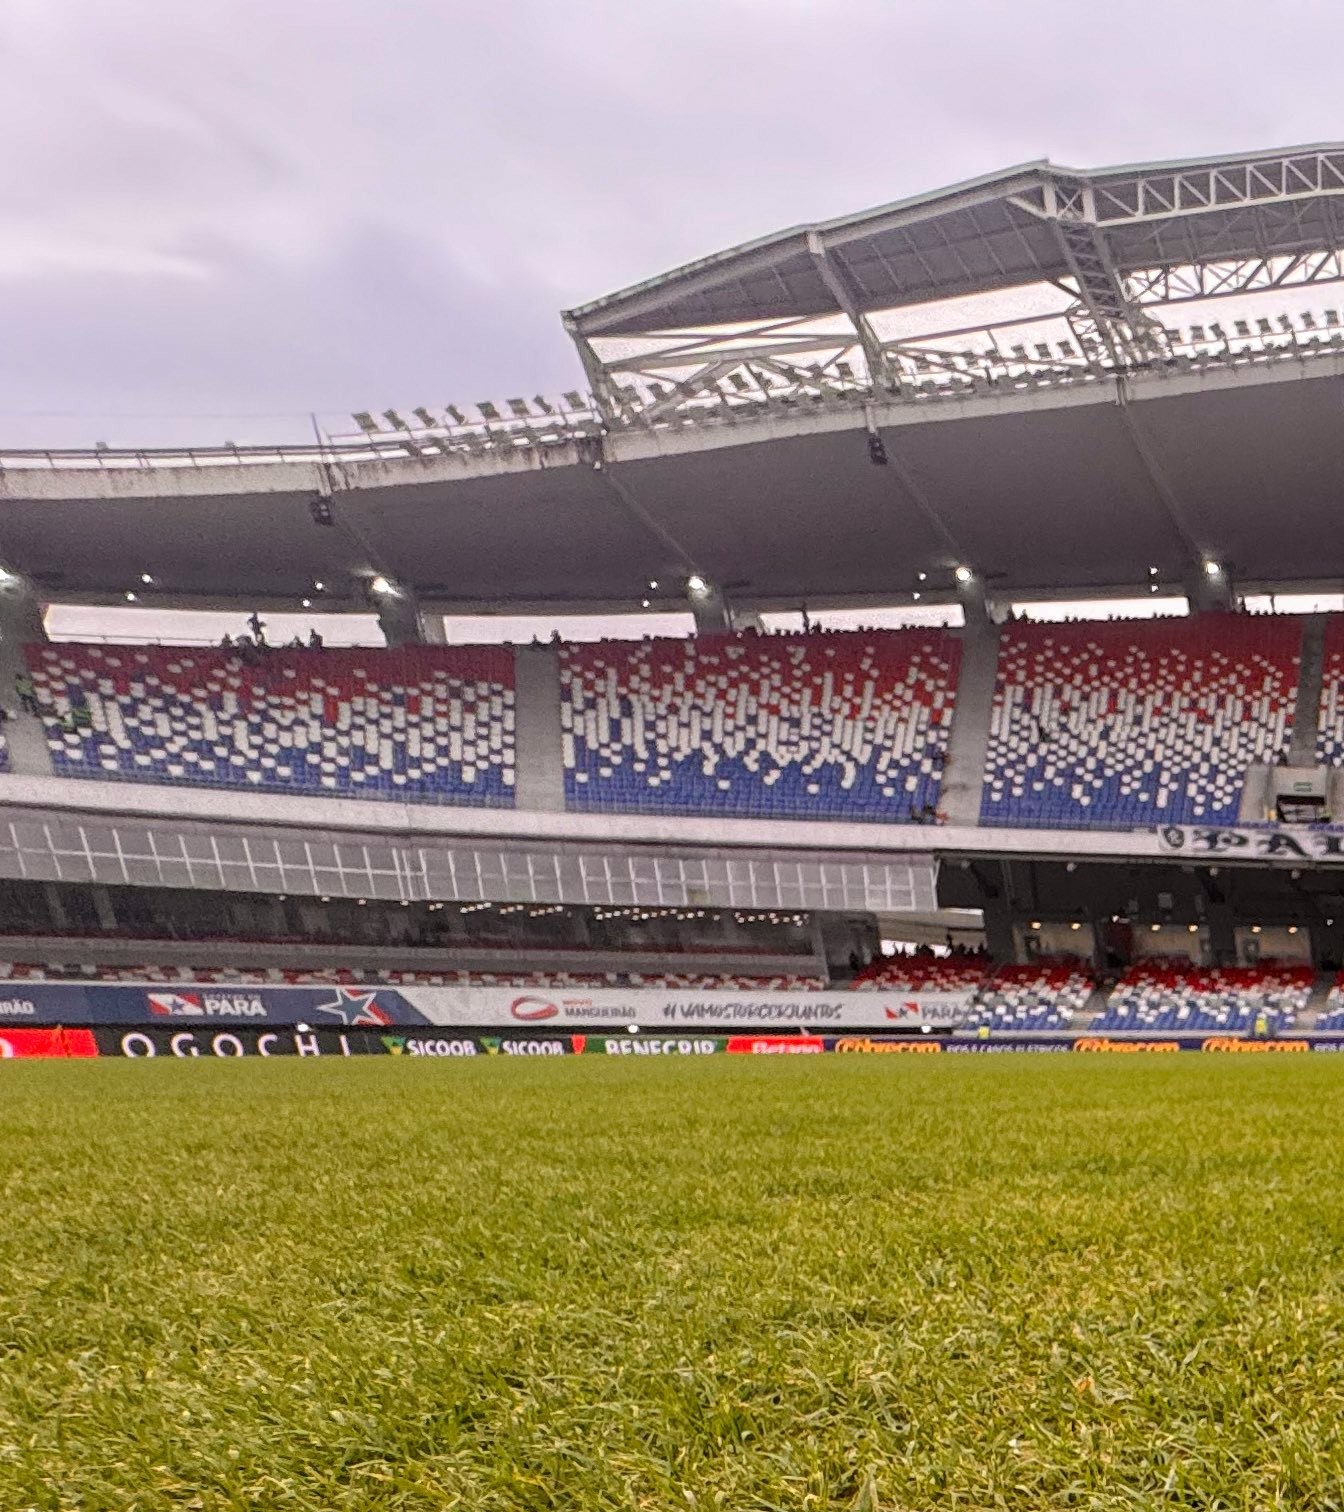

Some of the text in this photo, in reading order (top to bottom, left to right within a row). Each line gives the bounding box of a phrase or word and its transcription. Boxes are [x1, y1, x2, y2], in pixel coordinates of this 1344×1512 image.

[121, 1032, 350, 1057] OGOCHI
[406, 1039, 477, 1056] SICOOB
[502, 1040, 564, 1056] SICOOB
